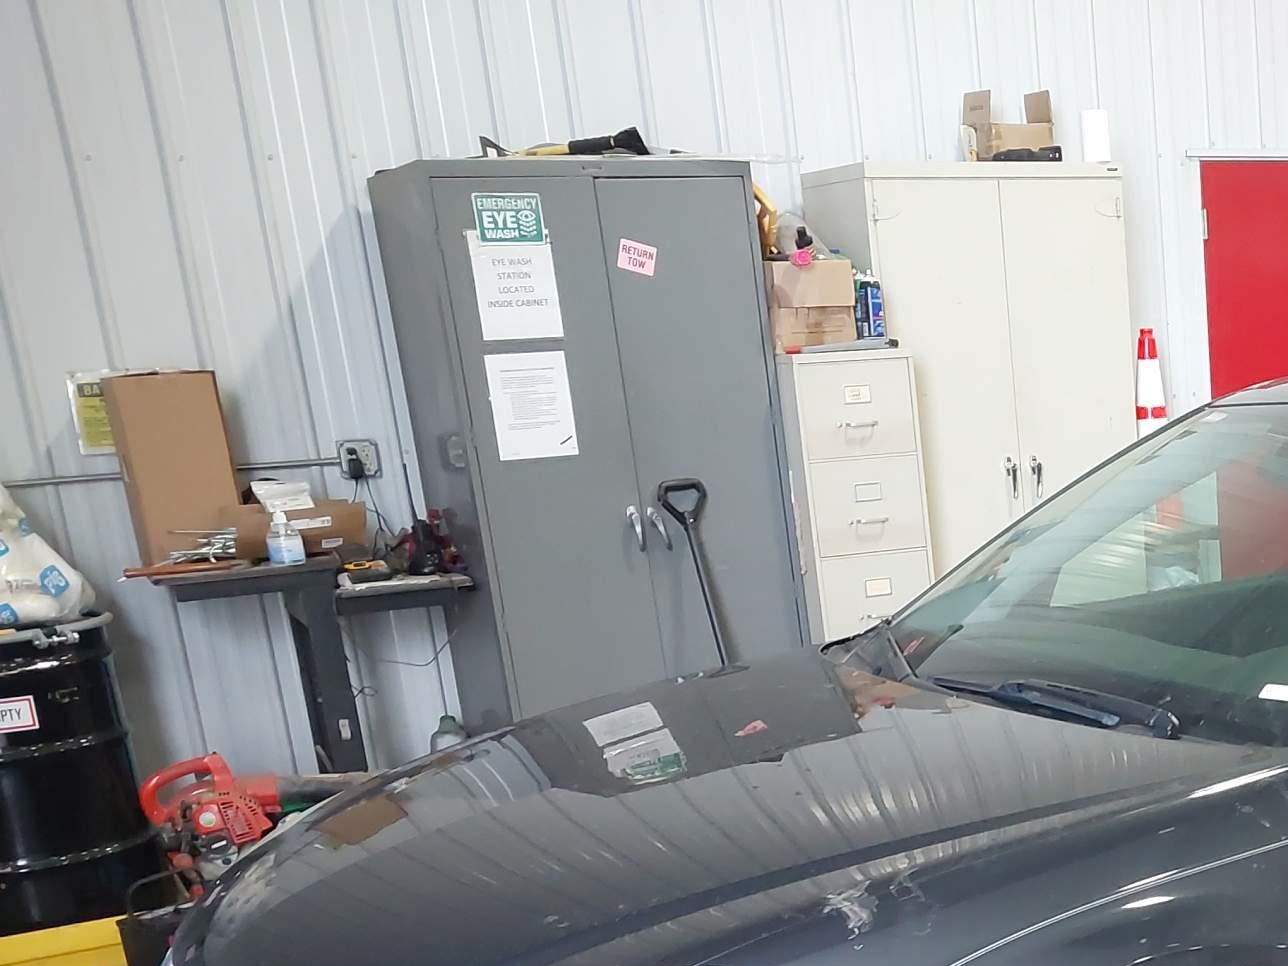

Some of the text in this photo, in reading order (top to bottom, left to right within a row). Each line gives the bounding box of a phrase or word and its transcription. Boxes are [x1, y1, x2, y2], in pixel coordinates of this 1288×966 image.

[476, 197, 537, 210] EMERGENCY
[481, 211, 518, 229] EYE
[484, 228, 519, 239] WASH
[621, 244, 655, 261] RETURN
[491, 257, 533, 266] EYE WASH
[627, 256, 646, 269] TOW
[497, 271, 532, 280] STATION
[498, 285, 535, 294] LOCATED
[487, 298, 549, 308] INSIDE CABINET
[0, 707, 22, 722] PTY
